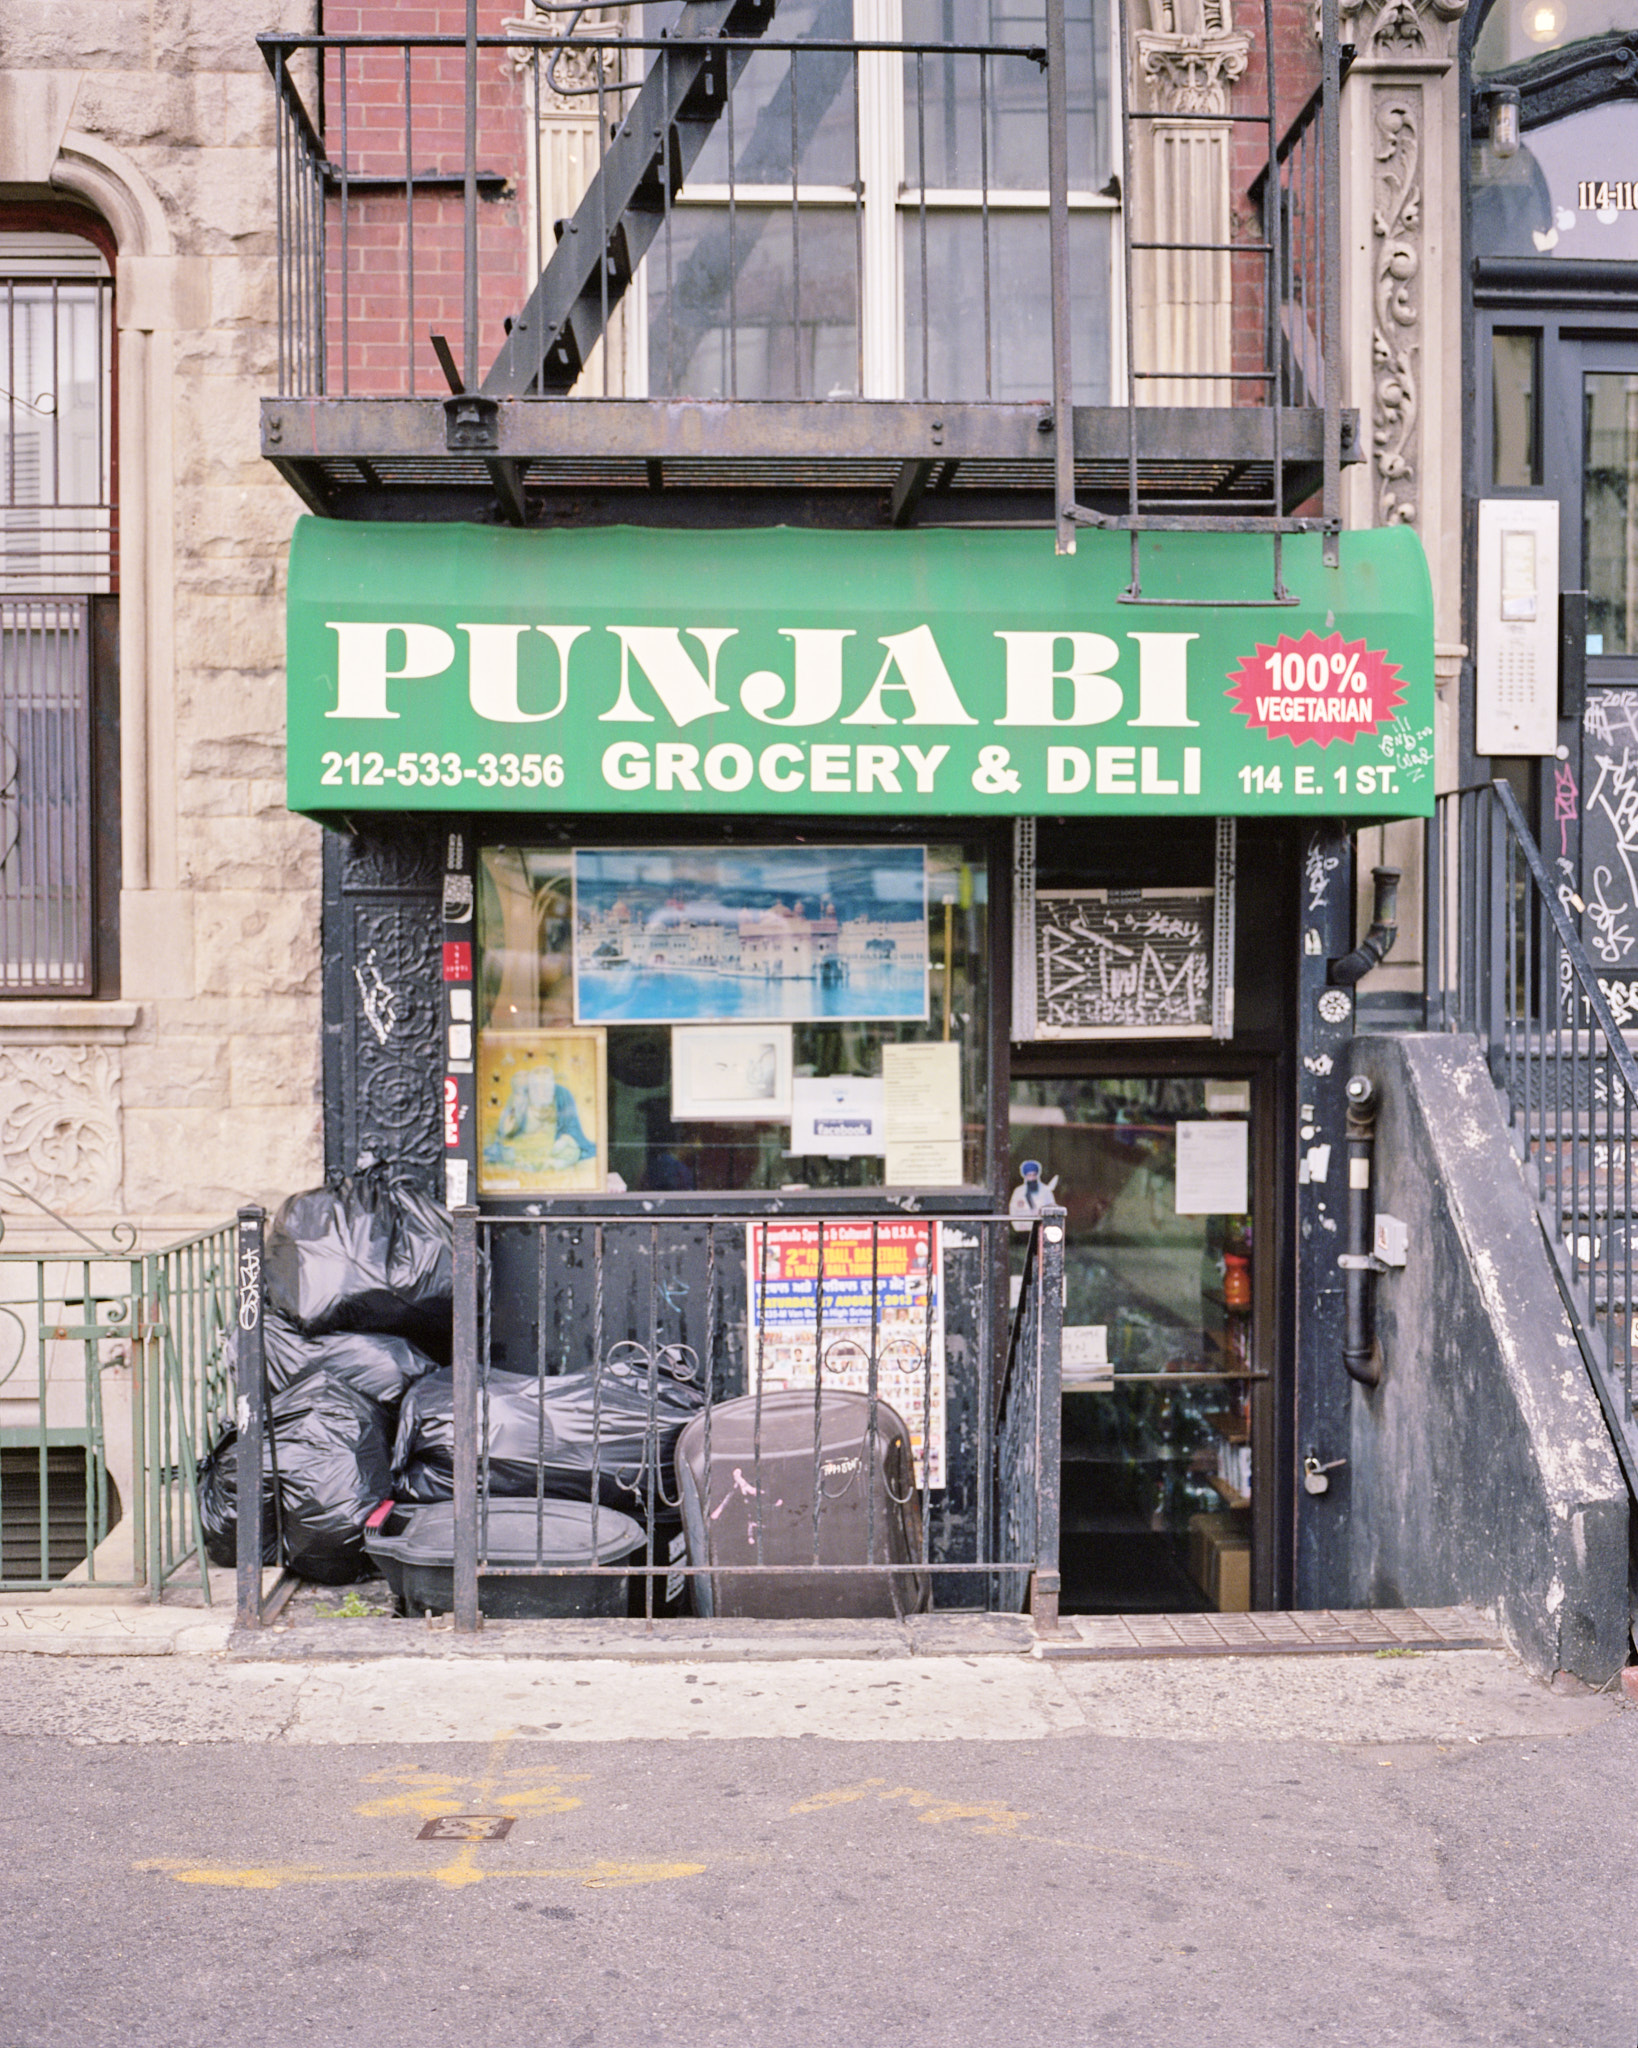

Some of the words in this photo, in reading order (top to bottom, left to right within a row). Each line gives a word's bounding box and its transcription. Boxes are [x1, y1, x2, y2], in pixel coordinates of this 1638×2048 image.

[324, 620, 1200, 728] PUNJABI
[1264, 651, 1368, 694] 100%
[1255, 695, 1373, 723] VEGETARIAN
[320, 751, 565, 788] 212-533-3356
[600, 740, 951, 794] GROCERY
[971, 744, 1022, 795] &
[1046, 746, 1200, 795] DELI
[1238, 764, 1283, 794] 114
[1294, 765, 1324, 795] E.
[1333, 766, 1347, 794] 1
[1355, 765, 1400, 795] ST.
[818, 1123, 868, 1135] facebook
